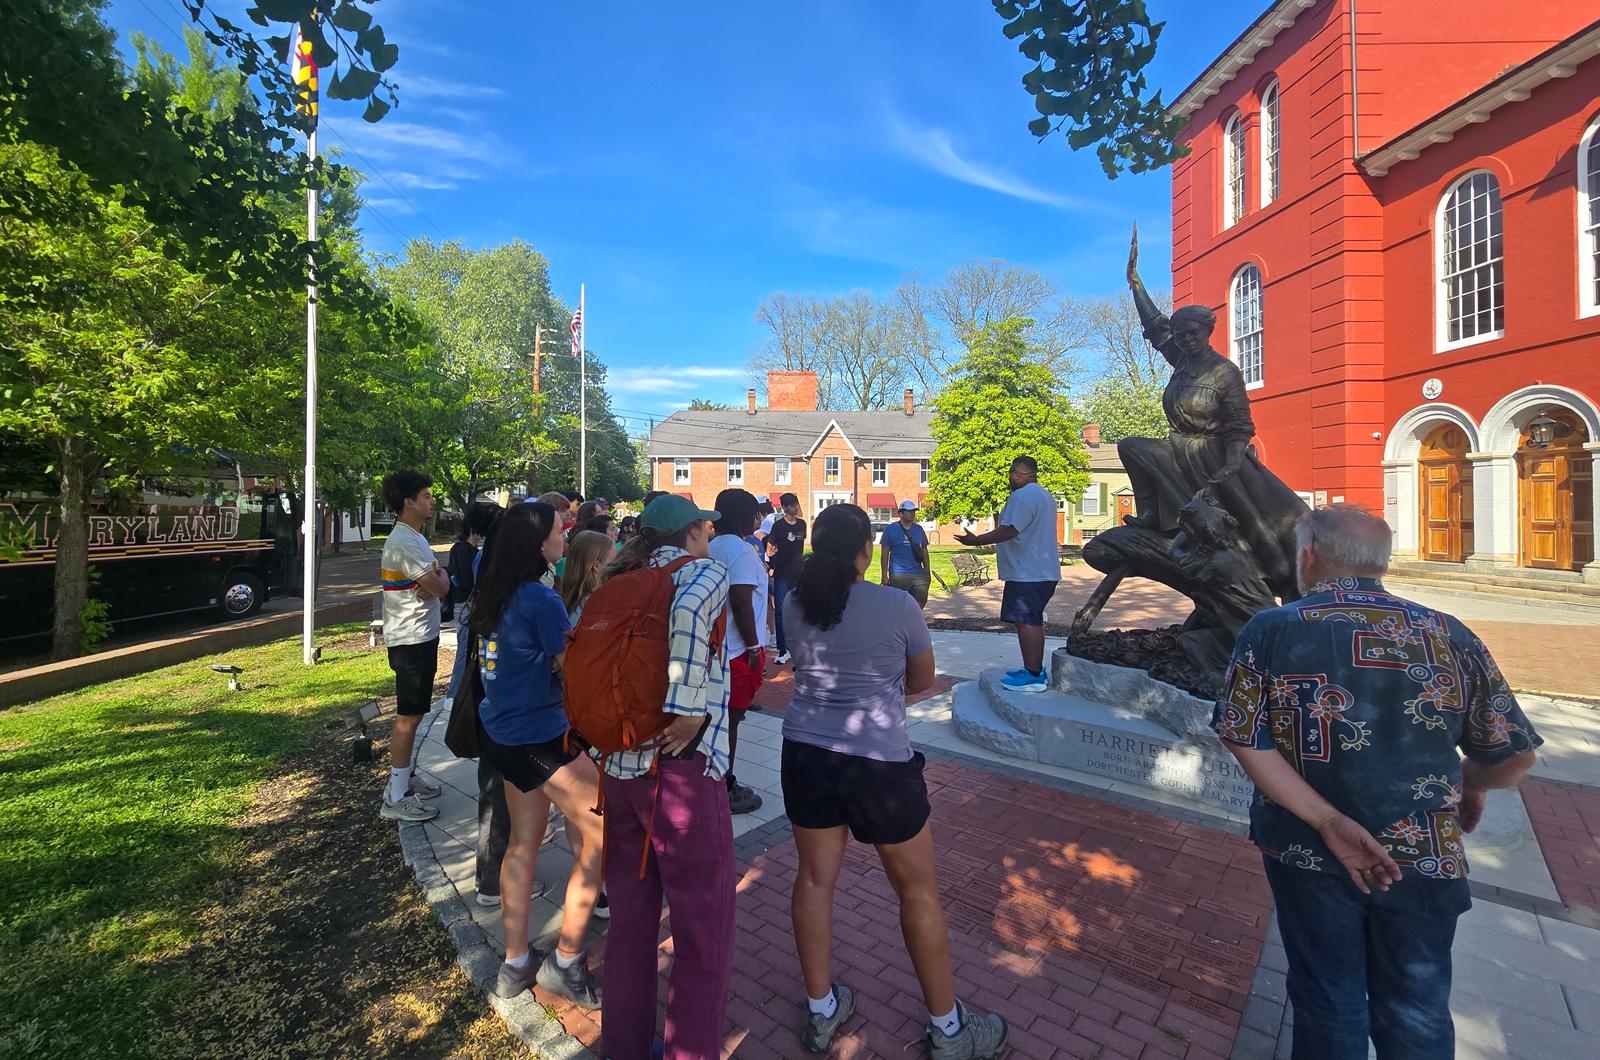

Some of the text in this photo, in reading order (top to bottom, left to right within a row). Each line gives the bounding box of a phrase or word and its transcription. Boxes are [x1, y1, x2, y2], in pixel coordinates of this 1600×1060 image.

[0, 503, 239, 548] MRYLAND
[1081, 729, 1173, 759] HARRIET
[1087, 759, 1156, 783] DORCHESTER
[1160, 777, 1205, 797] COUNTY
[1103, 752, 1131, 764] BORN
[1136, 760, 1193, 780] ARAMINTA
[1198, 775, 1225, 790] ROSS
